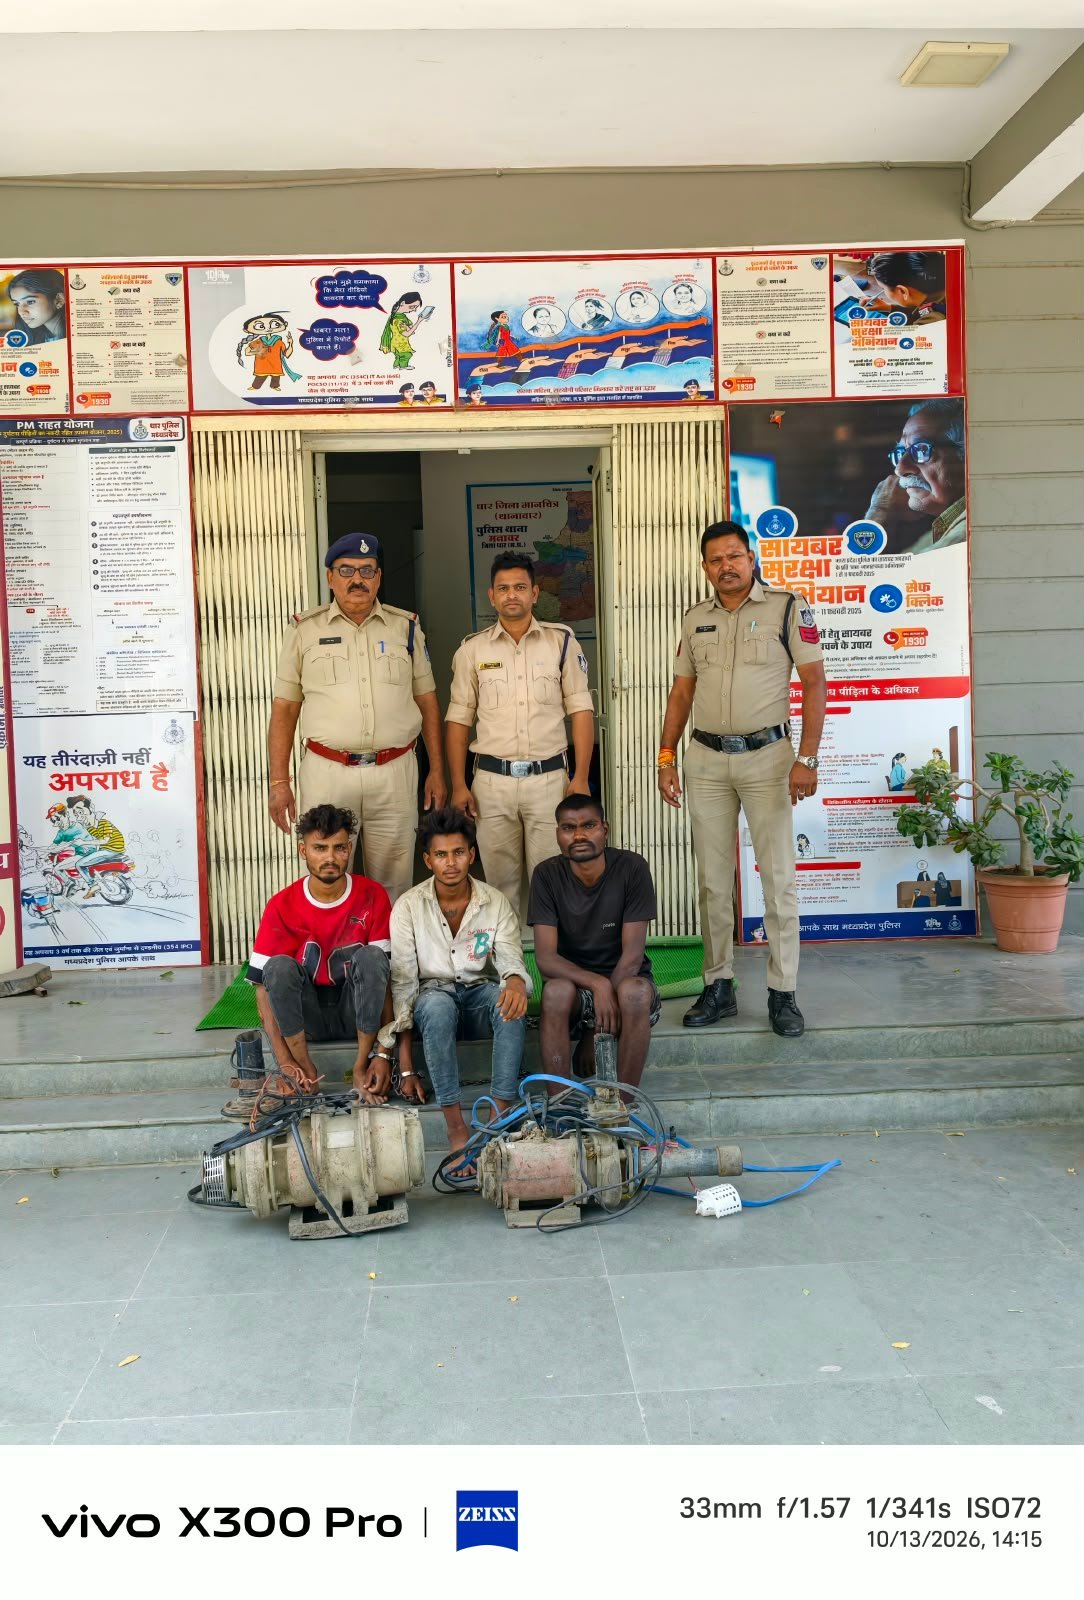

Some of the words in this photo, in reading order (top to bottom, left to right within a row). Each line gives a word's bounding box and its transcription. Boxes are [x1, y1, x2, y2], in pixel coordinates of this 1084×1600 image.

[852, 328, 882, 338] सुरक्षा
[852, 336, 898, 346] अभियान
[38, 421, 61, 430] राहत
[64, 419, 94, 429] योजना
[162, 421, 180, 430] पुलिस
[496, 500, 519, 509] जिला
[521, 499, 559, 508] मानचित्र
[495, 512, 542, 520] (थानावार)
[476, 524, 503, 536] पुलिस
[759, 537, 843, 557] सायबर
[761, 559, 832, 586] सुरक्षा
[906, 579, 931, 593] सेफ
[906, 594, 944, 608] क्लिक
[827, 607, 846, 615] फरवरी
[828, 629, 840, 640] हेतु
[841, 629, 872, 638] सायबर
[841, 640, 849, 650] के
[850, 641, 872, 649] उपाय
[903, 637, 925, 646] 1930
[839, 687, 868, 698] पीड़िता
[871, 685, 880, 695] के
[884, 684, 919, 695] अधिकार
[23, 755, 47, 768] यह
[51, 748, 117, 767] तीरंदाज़ी
[122, 747, 152, 765] नहीं
[48, 770, 142, 792] अपराध
[150, 762, 169, 792] है
[842, 922, 876, 930] मध्यप्रदेश
[879, 920, 901, 931] पुलिस
[96, 956, 116, 965] पुलिस
